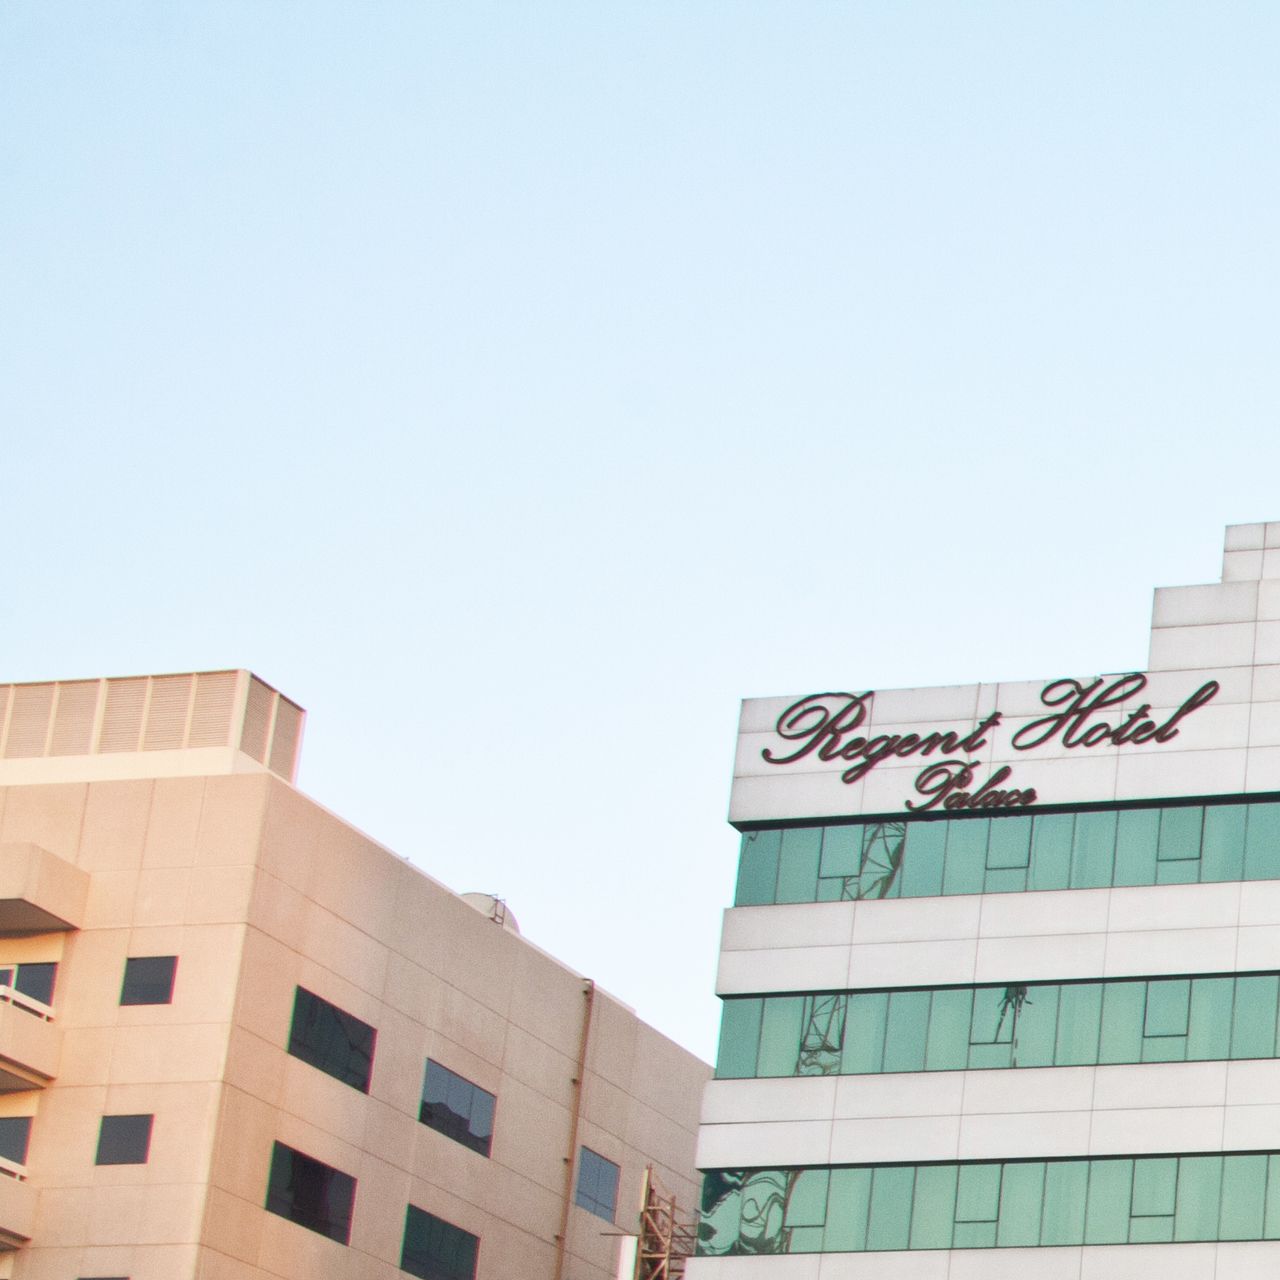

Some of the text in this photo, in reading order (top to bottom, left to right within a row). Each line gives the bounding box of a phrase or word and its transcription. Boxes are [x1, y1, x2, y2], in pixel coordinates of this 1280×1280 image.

[762, 672, 1220, 785] Regent Hotel
[905, 760, 1037, 812] Palace
